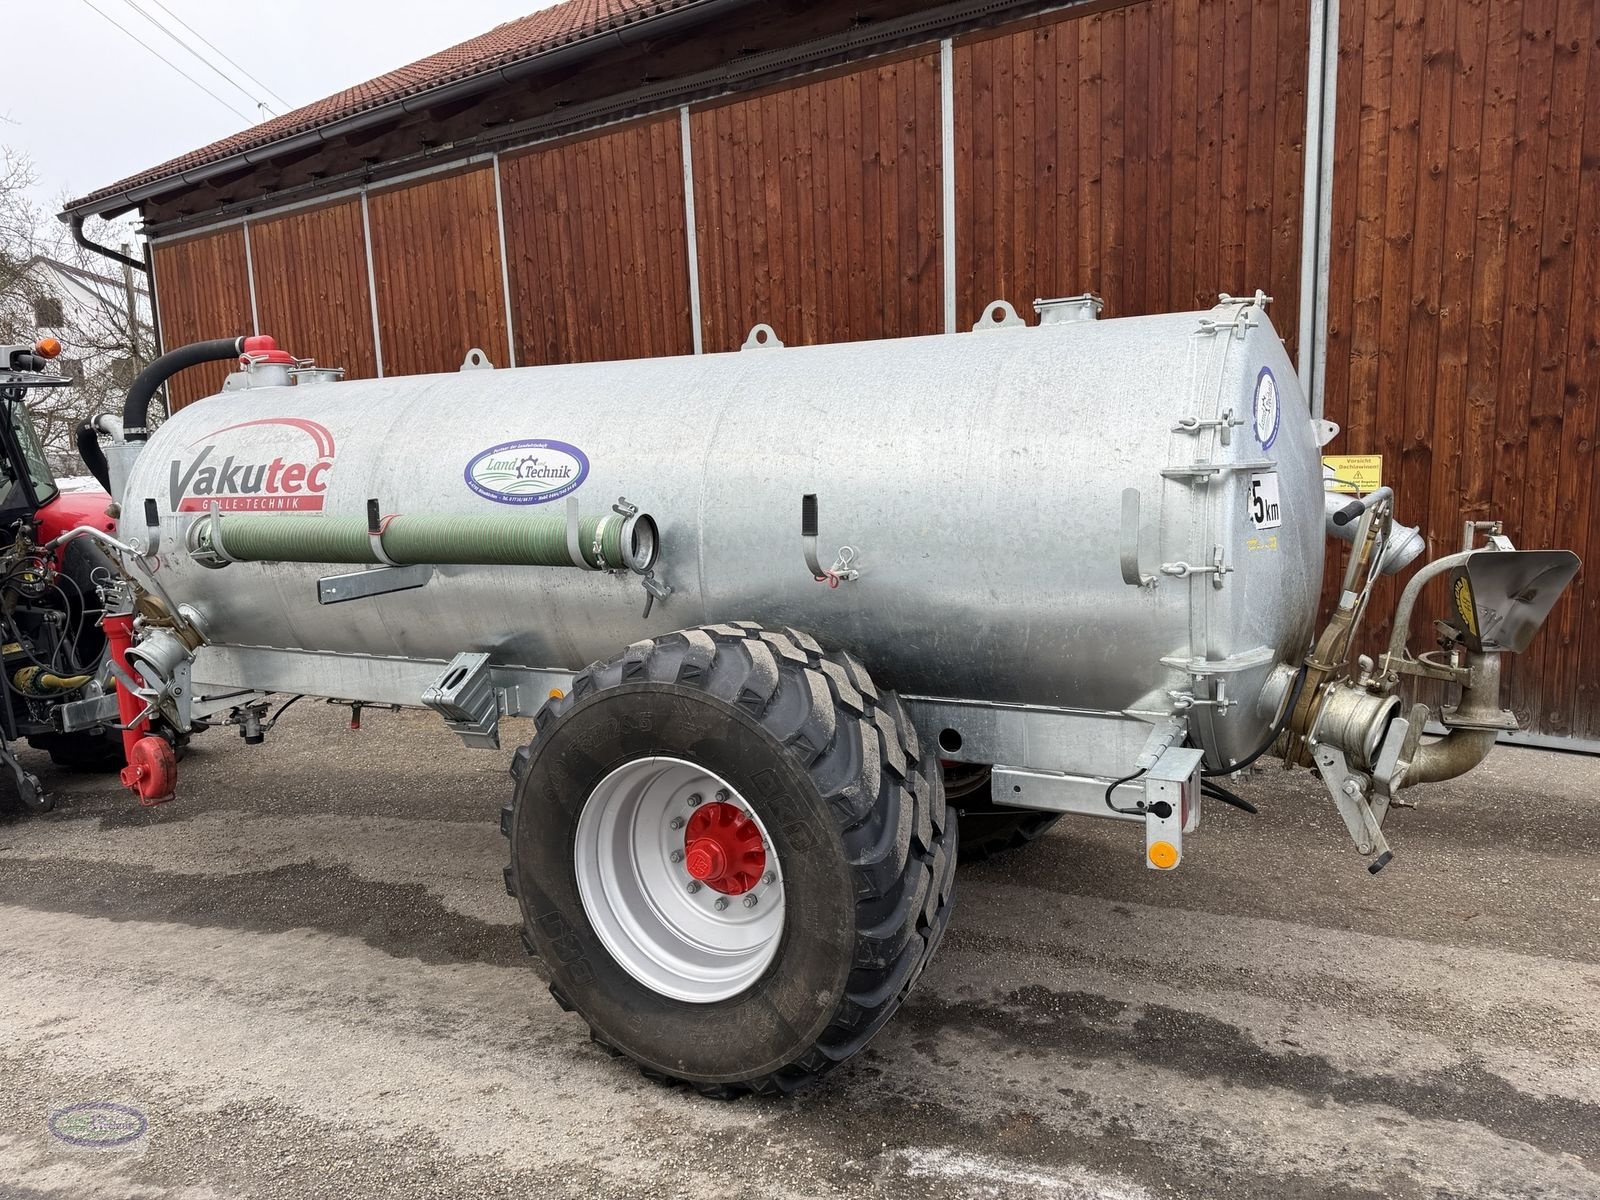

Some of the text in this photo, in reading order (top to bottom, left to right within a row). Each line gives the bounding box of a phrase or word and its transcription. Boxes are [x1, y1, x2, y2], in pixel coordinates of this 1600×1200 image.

[486, 458, 518, 471] Land
[169, 445, 332, 512] Vakutec
[525, 465, 572, 479] Technik
[202, 497, 300, 511] GLLE-TECHNIK
[1265, 499, 1280, 521] km
